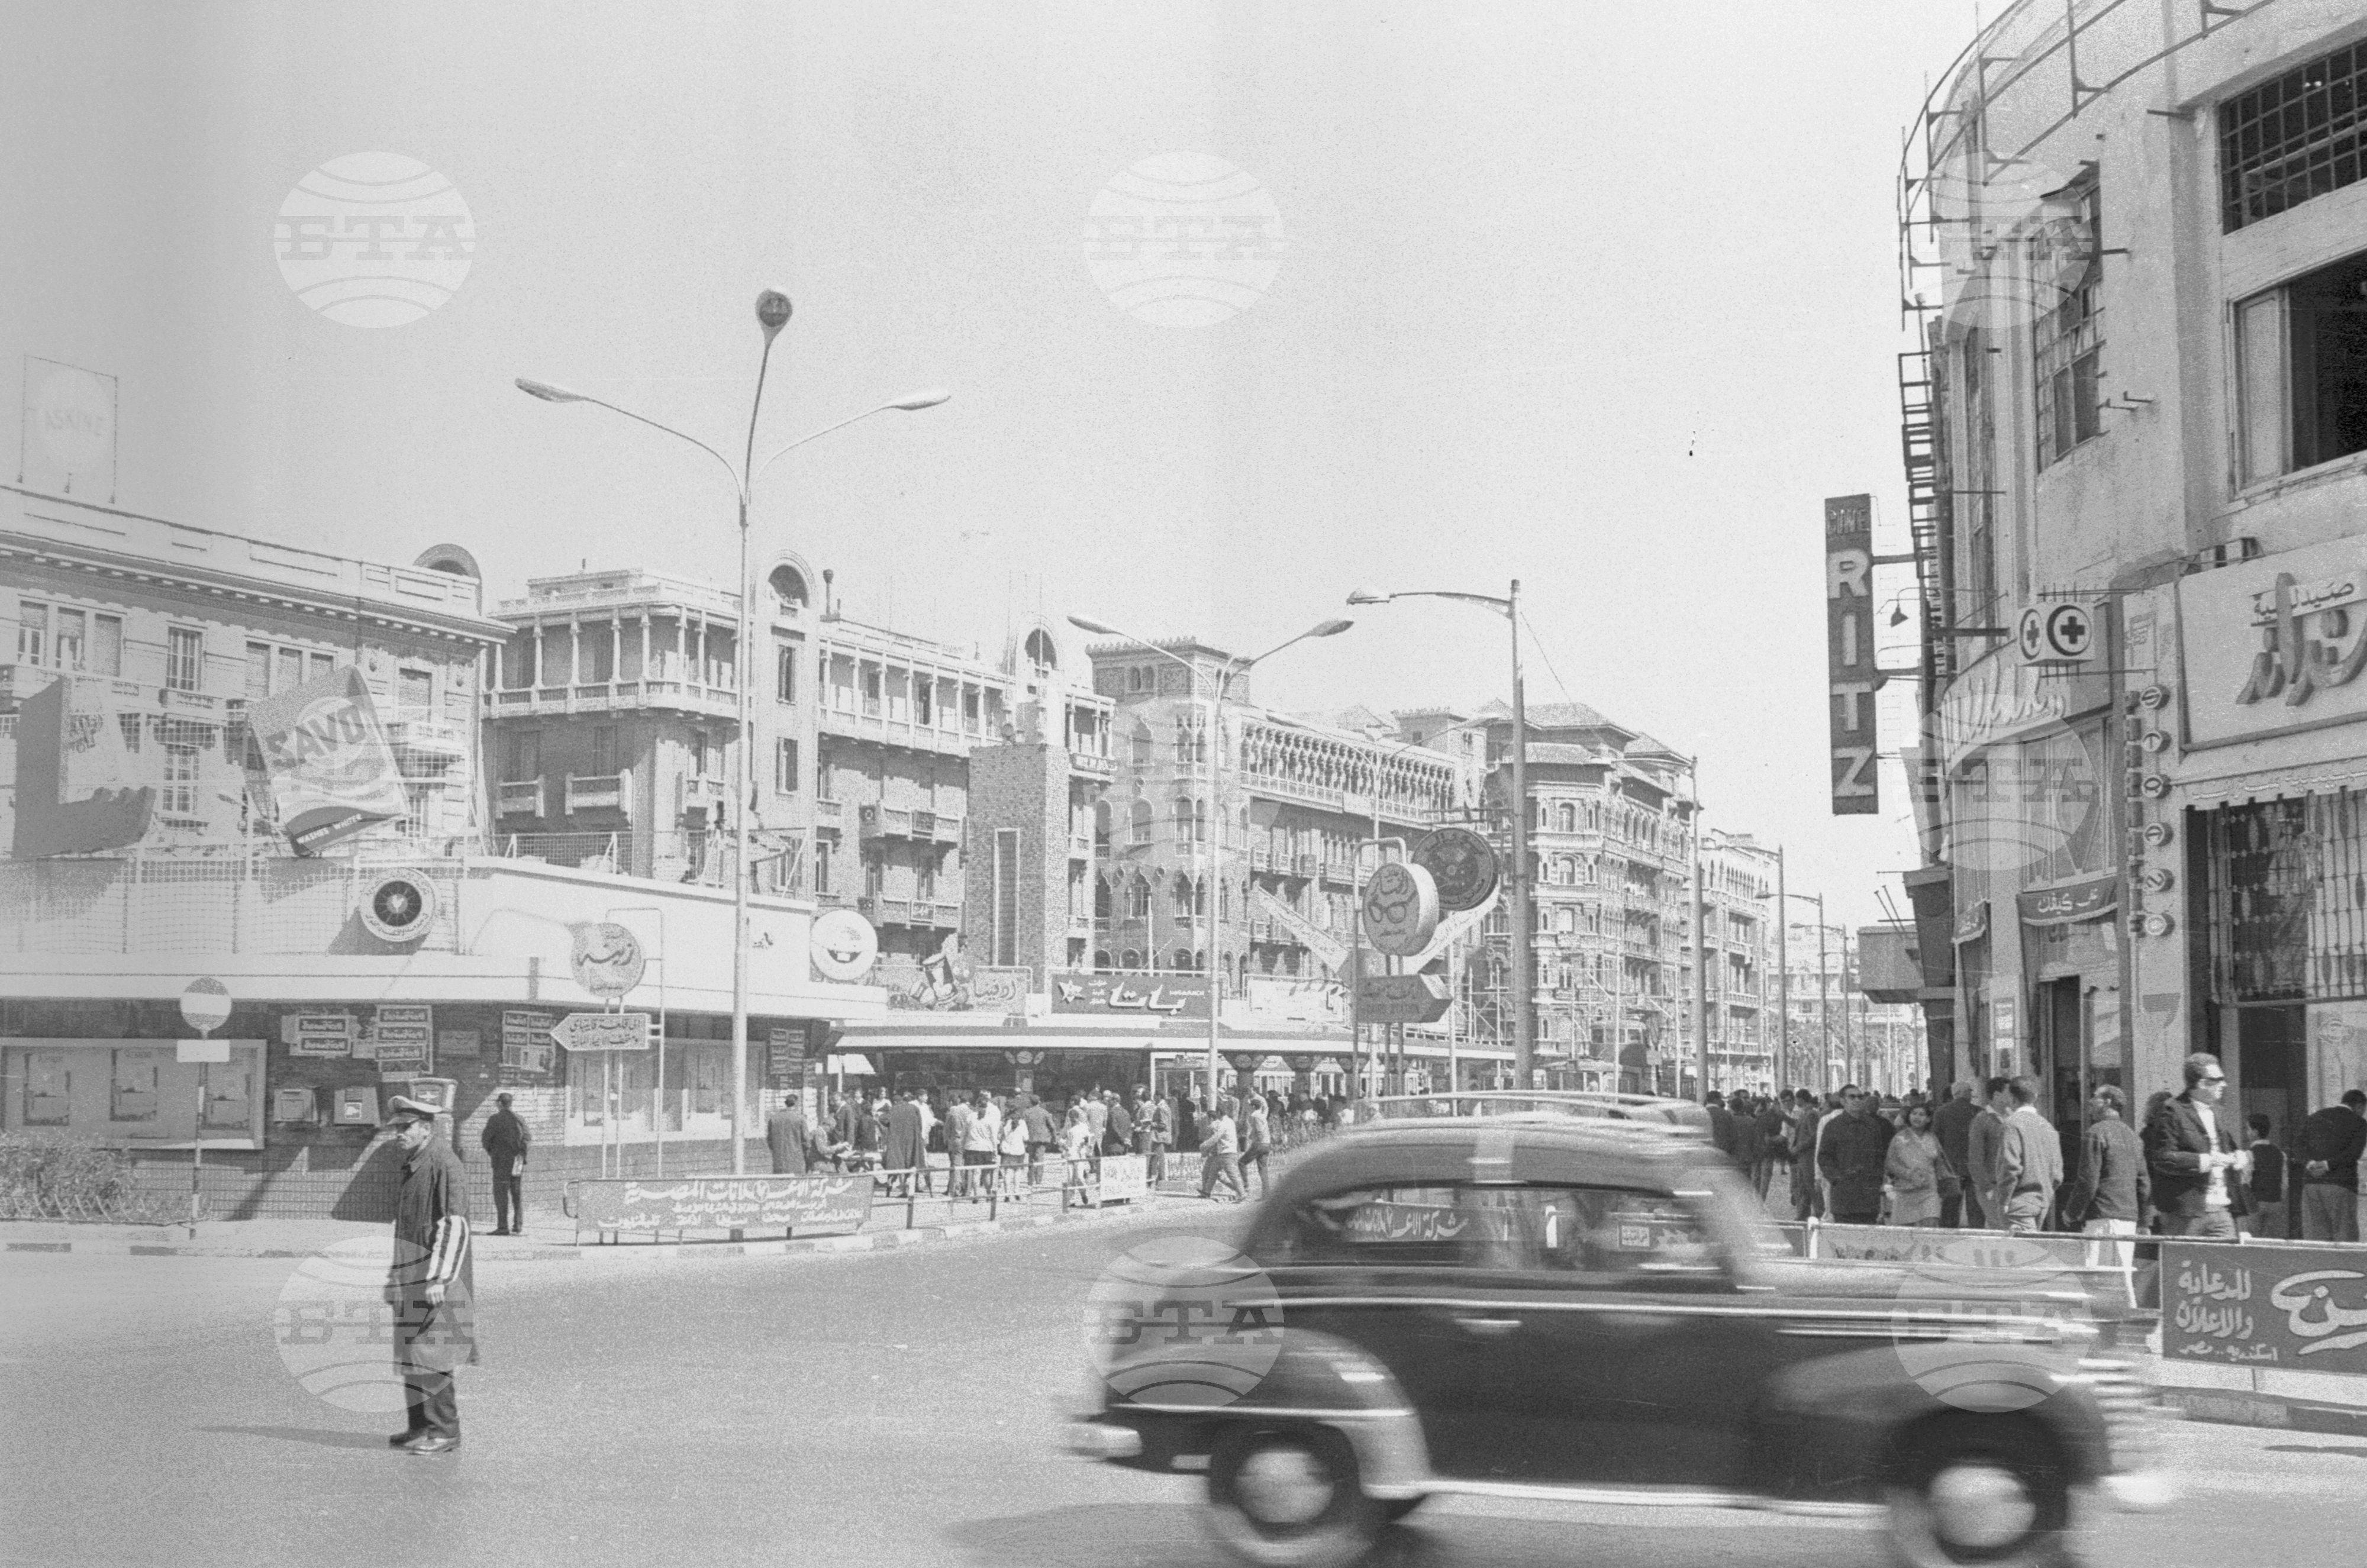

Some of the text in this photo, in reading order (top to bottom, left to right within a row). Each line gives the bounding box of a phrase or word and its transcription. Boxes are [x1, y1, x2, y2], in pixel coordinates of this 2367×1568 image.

[1826, 507, 1870, 535] CINE
[1828, 549, 1875, 798] RITZ
[265, 705, 367, 769] SAVO
[1110, 980, 1187, 1015] باتا
[624, 1180, 705, 1205] المصرية
[811, 1176, 853, 1199] شركة
[2178, 1259, 2253, 1301] للدعاية
[2175, 1295, 2255, 1340] والاعلان
